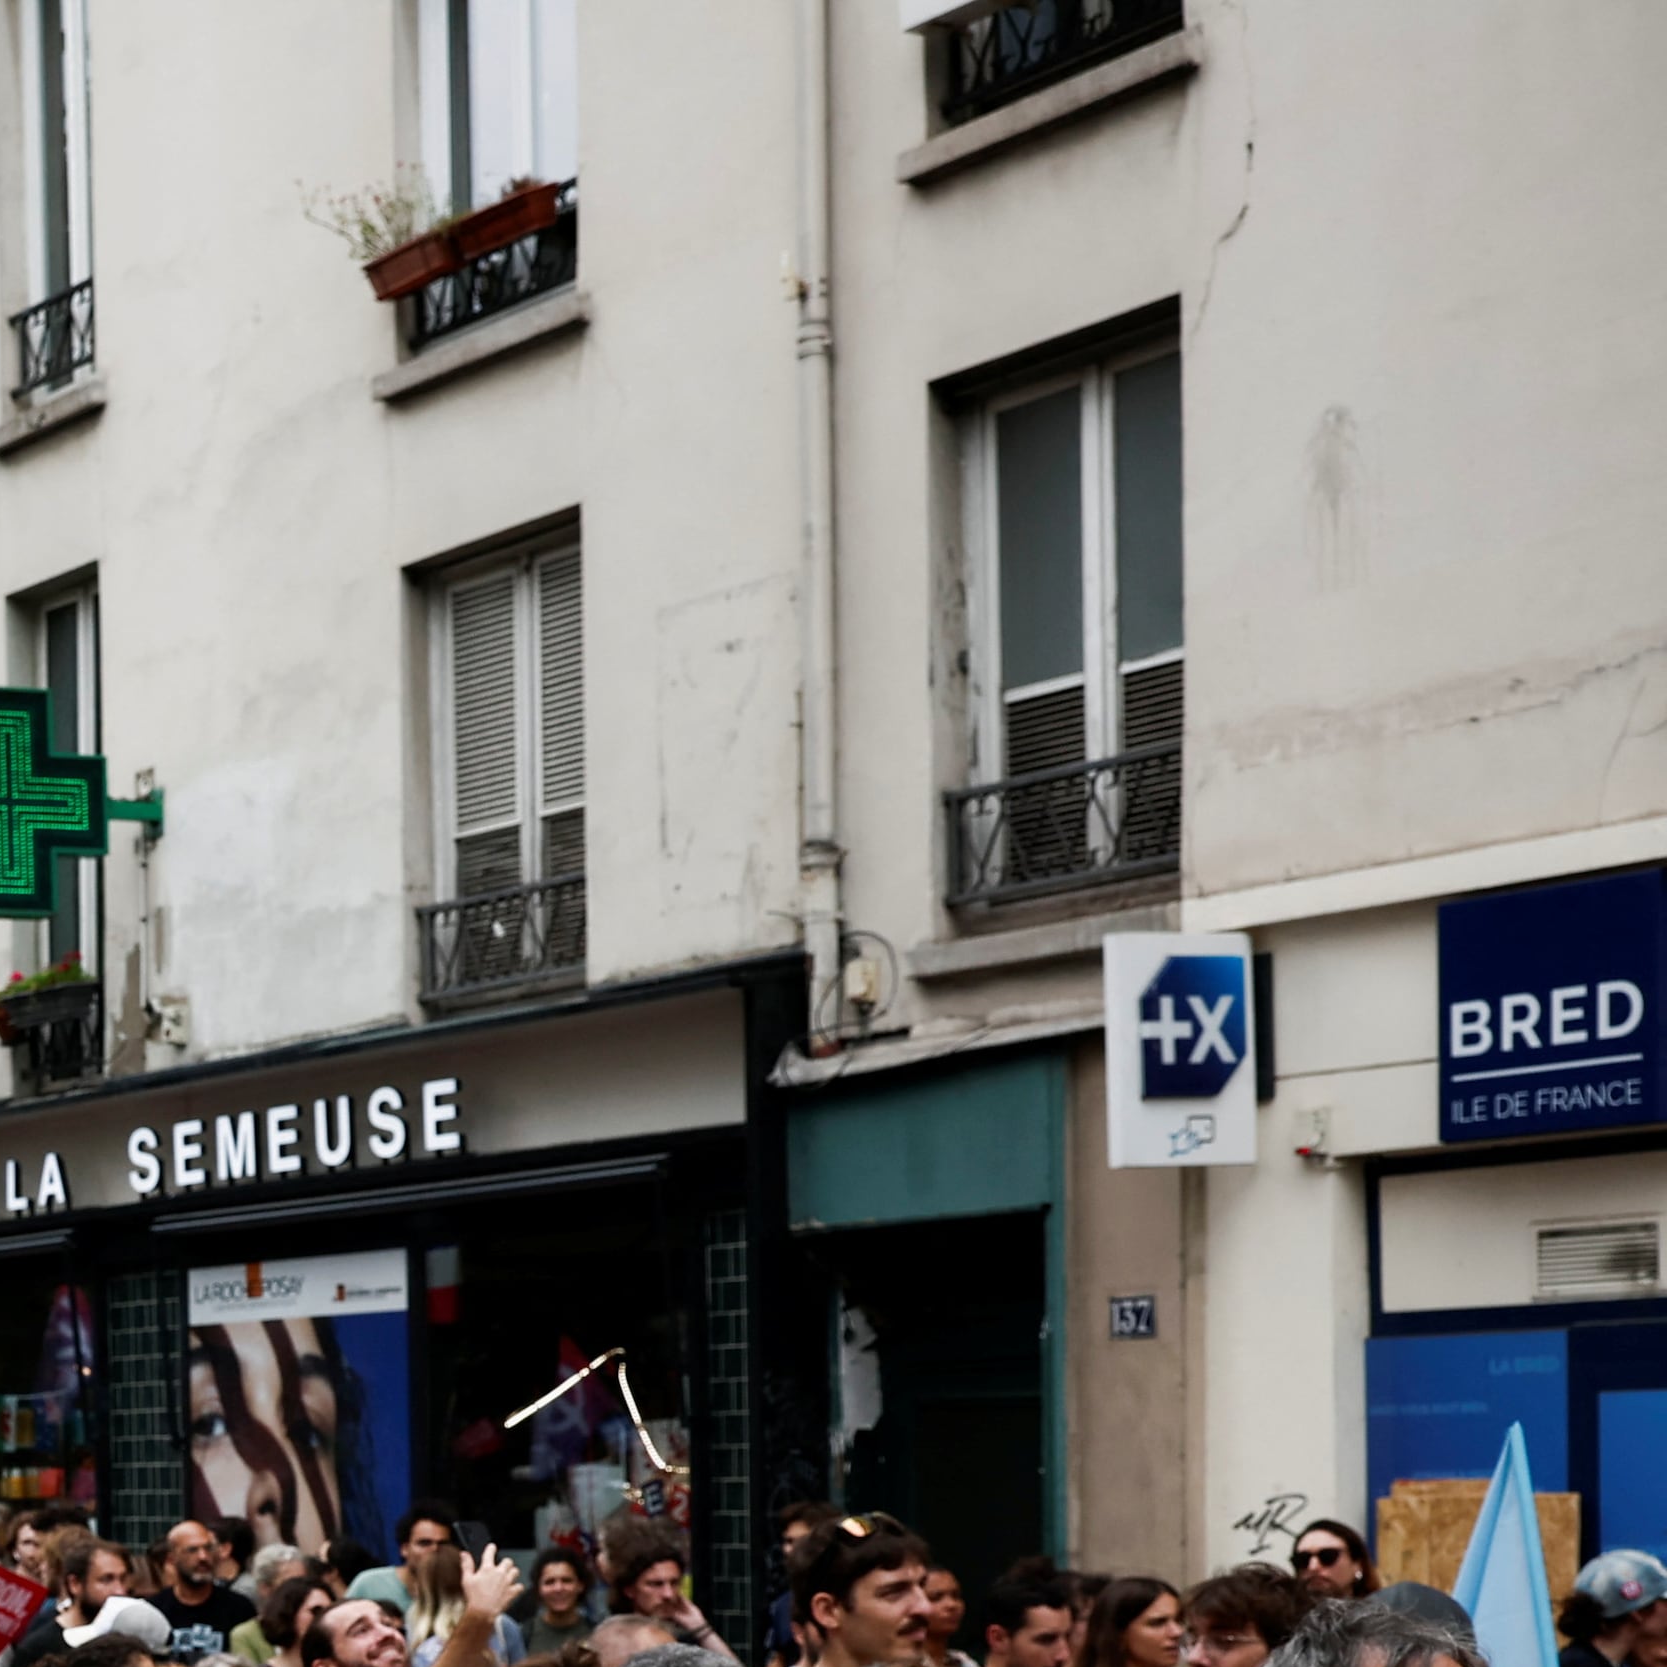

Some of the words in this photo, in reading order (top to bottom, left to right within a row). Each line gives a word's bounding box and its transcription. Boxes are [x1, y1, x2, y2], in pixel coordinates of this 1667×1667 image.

[1449, 979, 1644, 1058] BRED
[1451, 1095, 1488, 1124] ILE
[1494, 1090, 1529, 1119] DE
[1535, 1078, 1642, 1114] FRANCE
[5, 1152, 68, 1212] LA
[127, 1077, 463, 1194] SEMEUSE
